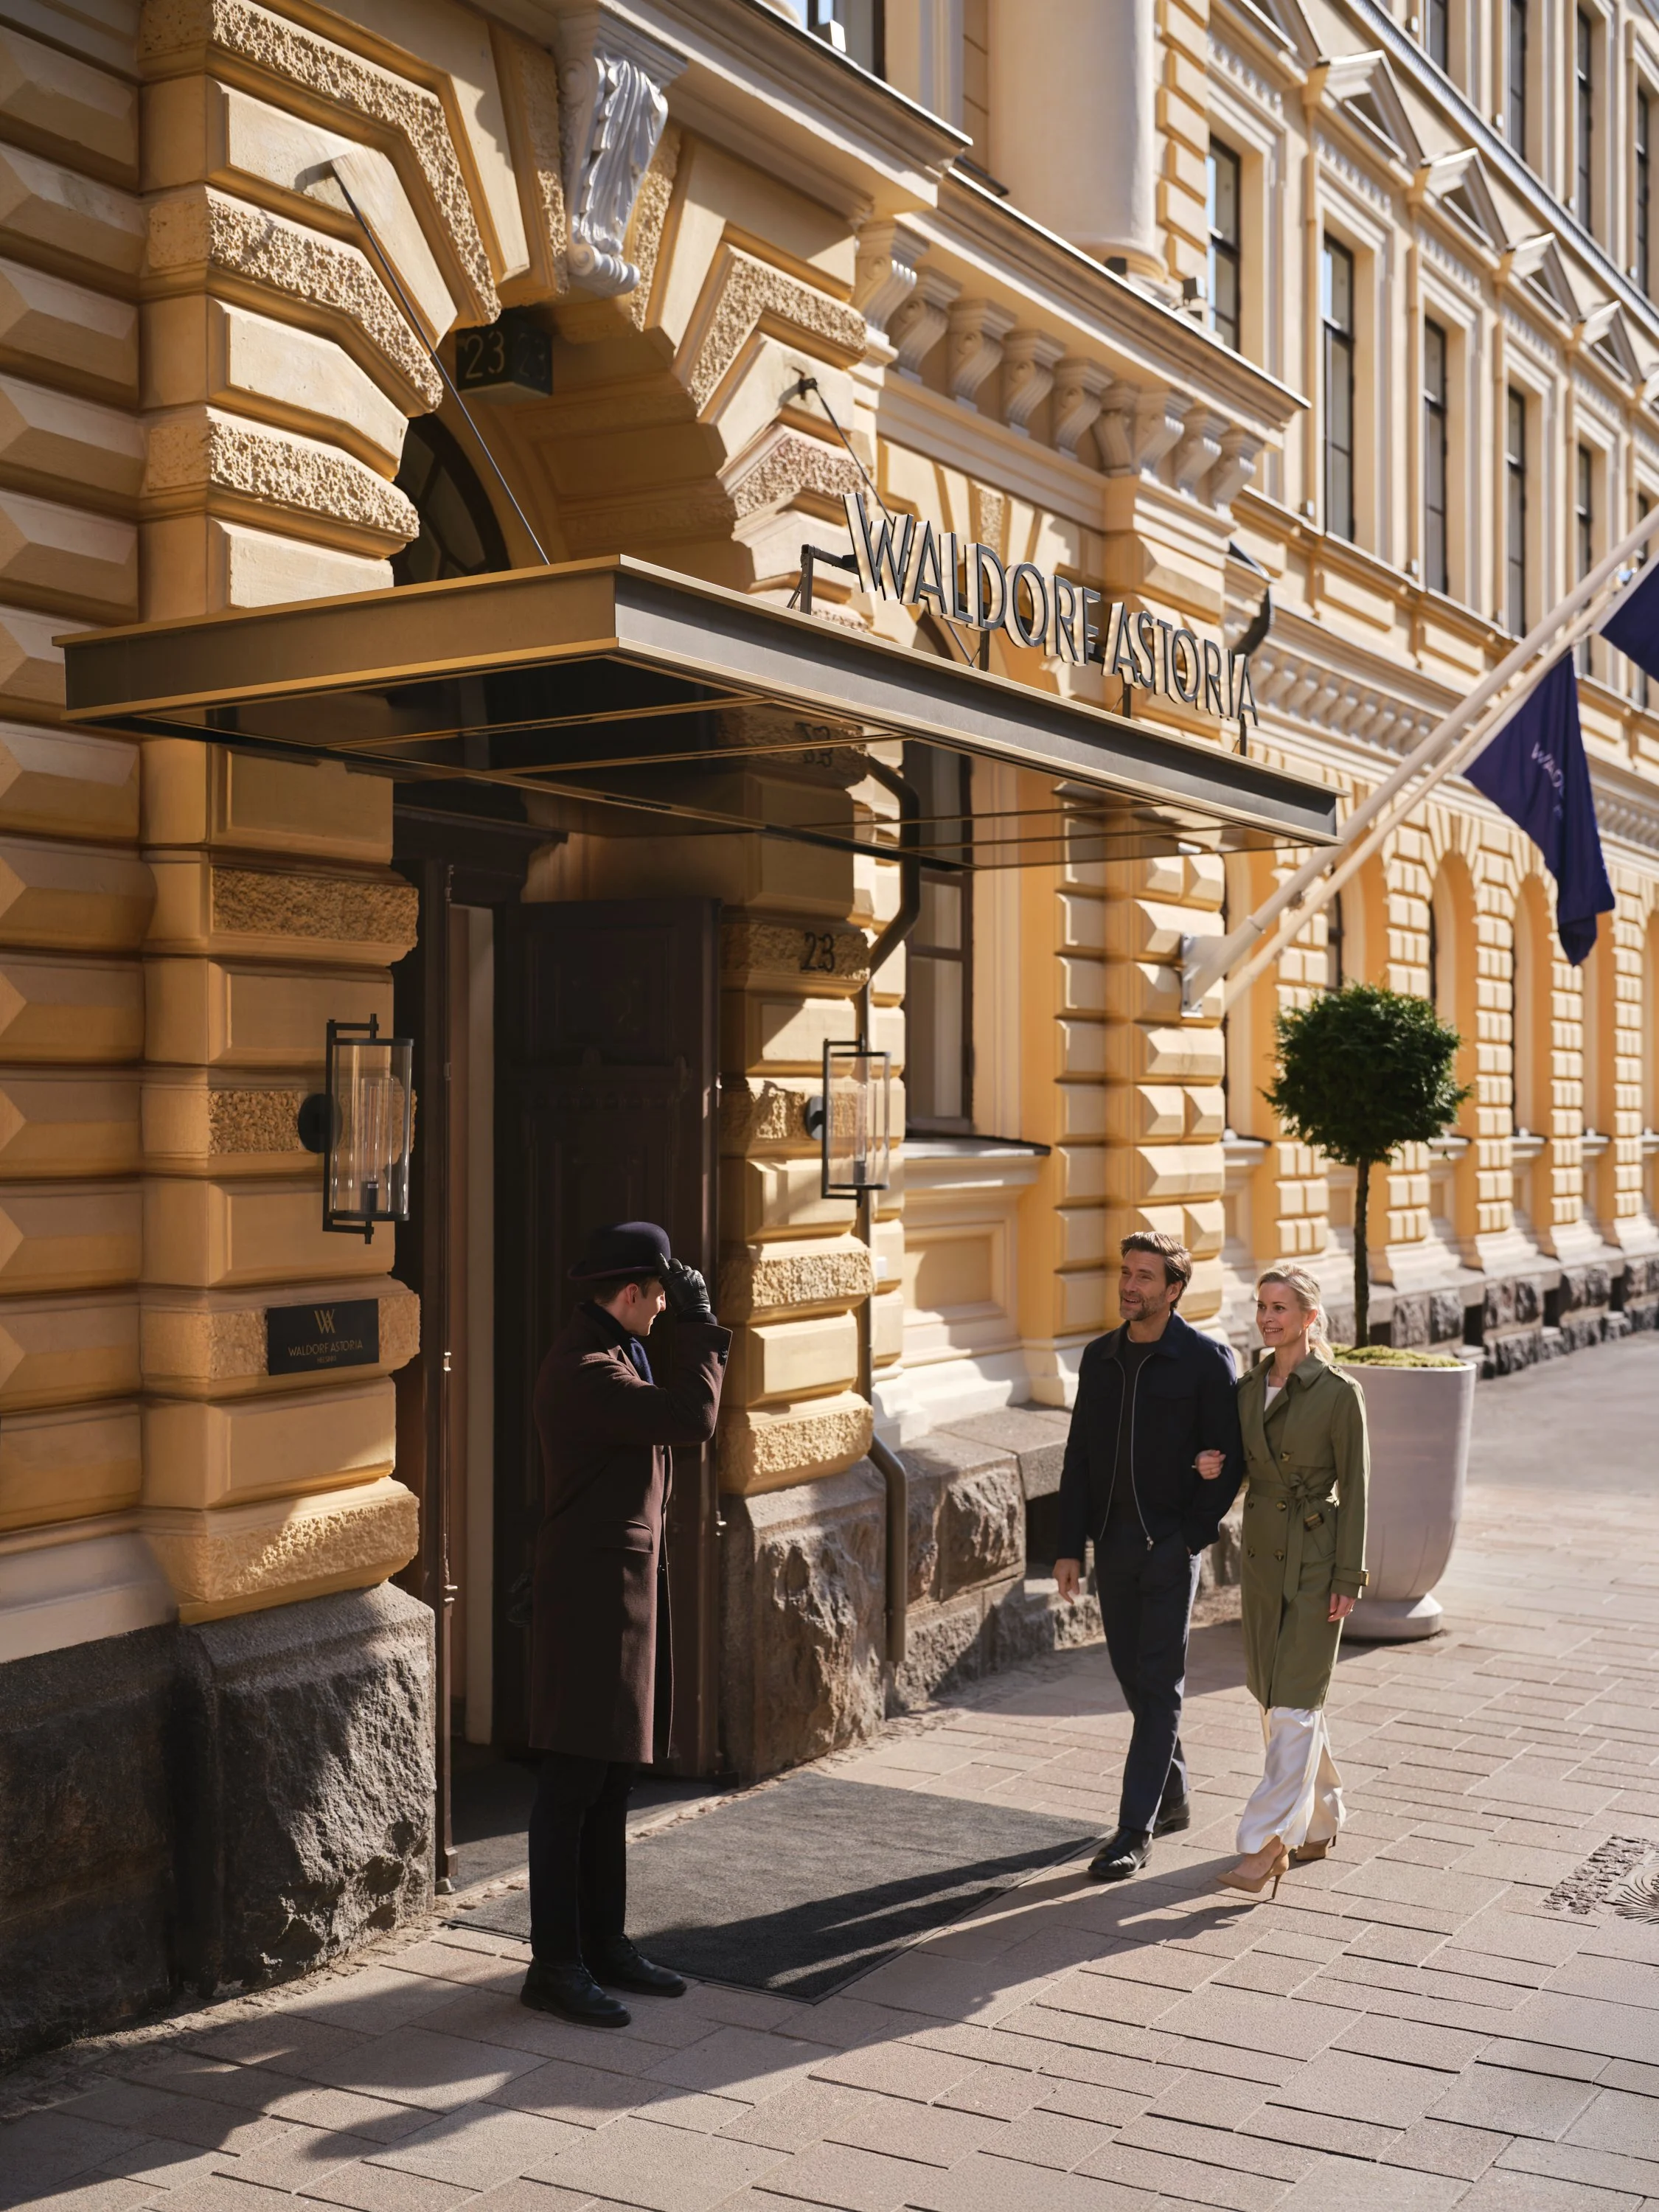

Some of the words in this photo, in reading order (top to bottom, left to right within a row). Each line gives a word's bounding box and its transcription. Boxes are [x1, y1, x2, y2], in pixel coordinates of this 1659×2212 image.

[465, 330, 505, 379] 23
[844, 492, 1102, 667] WALDORF
[1103, 601, 1259, 726] ASTORIA
[800, 931, 835, 973] 23
[288, 1342, 329, 1357] WALDORF
[330, 1338, 364, 1353] ASTORIA
